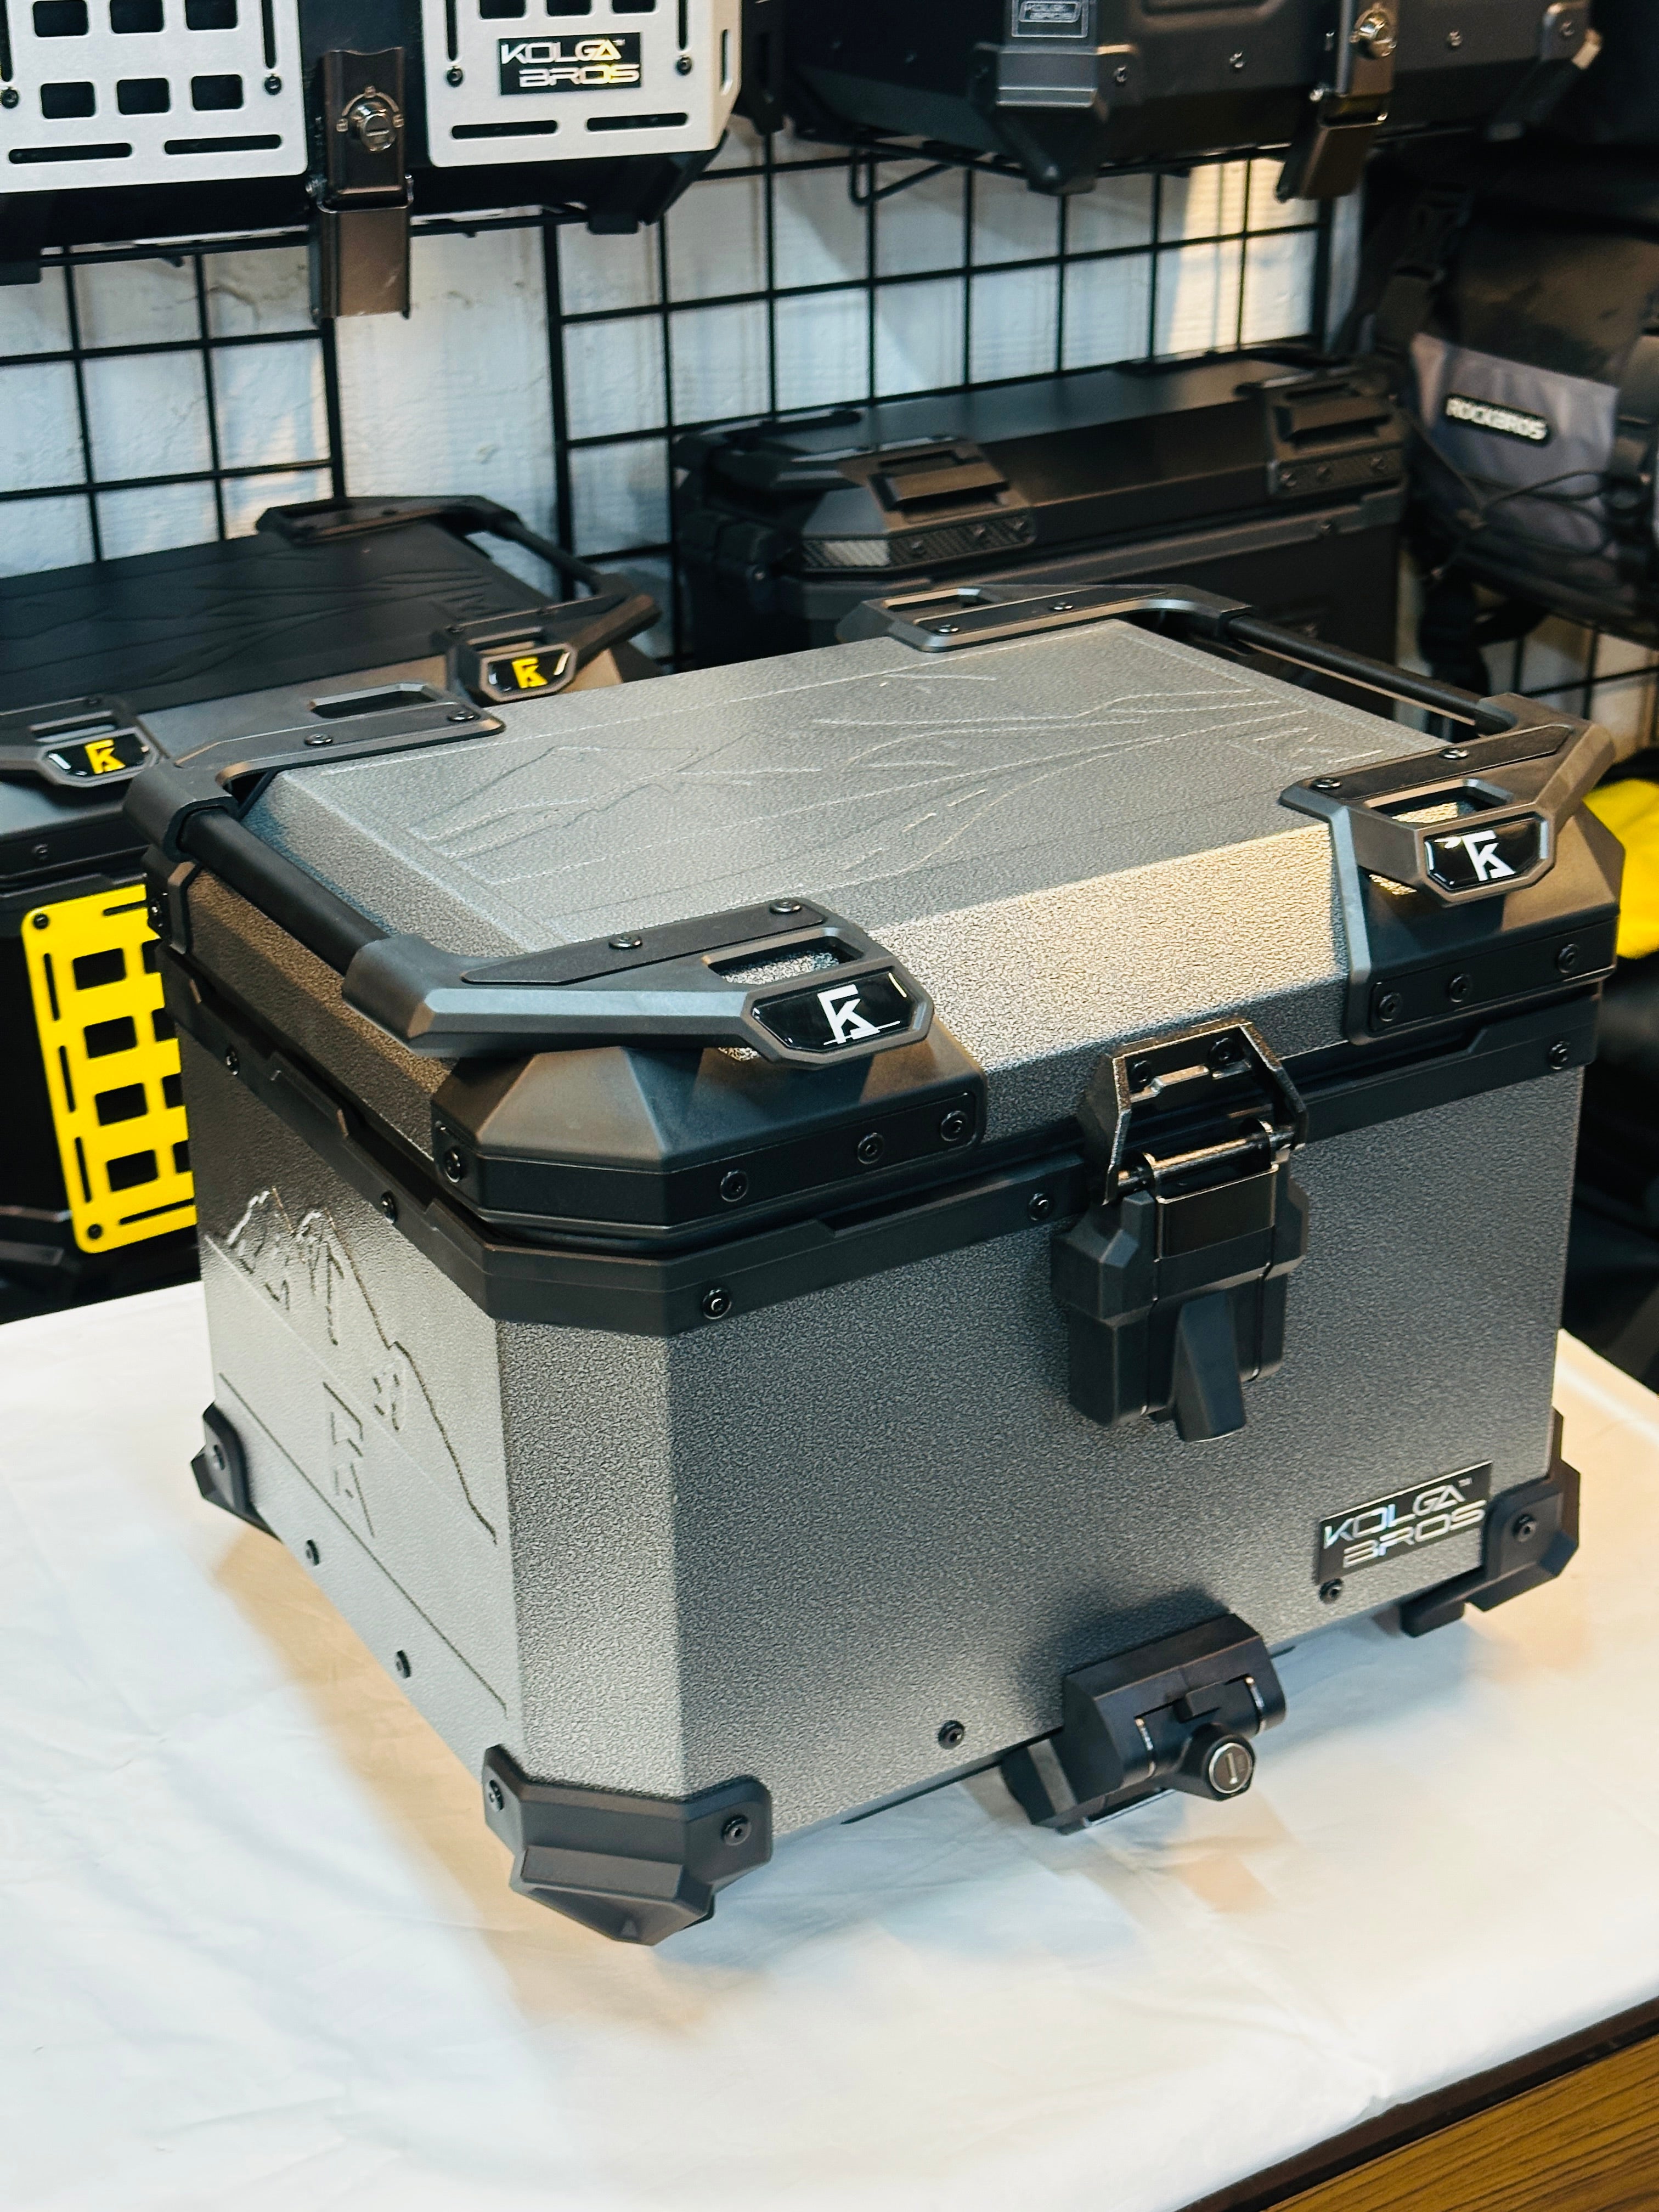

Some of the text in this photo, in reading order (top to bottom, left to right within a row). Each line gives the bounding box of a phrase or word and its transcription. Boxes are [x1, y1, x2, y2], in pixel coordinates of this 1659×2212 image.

[500, 38, 622, 64] KOLGA
[518, 63, 641, 87] BROS
[1324, 1485, 1465, 1549] KOLGA
[1343, 1499, 1487, 1568] BROS
